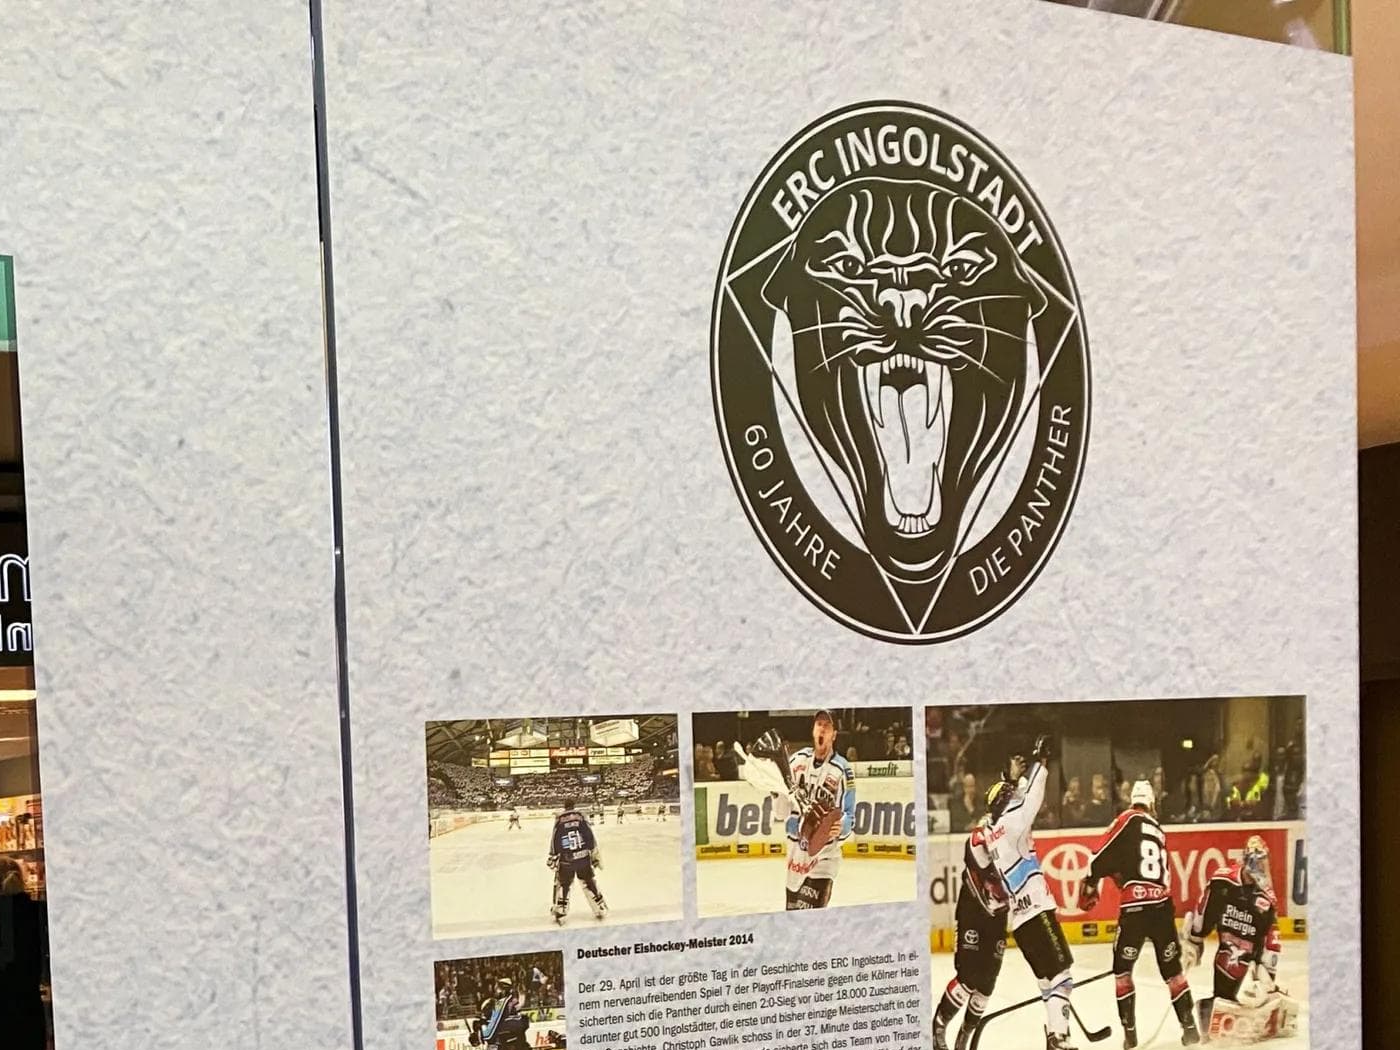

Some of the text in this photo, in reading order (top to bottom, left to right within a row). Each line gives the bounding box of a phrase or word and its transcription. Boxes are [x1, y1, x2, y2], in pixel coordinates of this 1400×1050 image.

[771, 125, 1042, 256] ERC INGOLSTADT
[744, 423, 841, 580] 60 JAHRE
[969, 402, 1073, 596] DIE PANTHER
[716, 793, 772, 837] bet
[1221, 913, 1257, 937] Energie
[1226, 904, 1253, 923] Rhein
[576, 932, 754, 960] Deutscher Eishockey-Meister 2014
[578, 982, 596, 994] Der
[619, 976, 641, 992] April
[644, 975, 657, 988] ist
[658, 974, 676, 986] der
[678, 971, 708, 987] größte
[710, 969, 728, 983] Tag
[730, 968, 742, 979] in
[742, 966, 759, 978] der
[760, 962, 809, 976] Geschichte
[811, 960, 829, 971] des
[830, 956, 849, 969] ERC
[897, 951, 906, 962] In
[578, 966, 920, 1011] nem nervenaufreibenden Spiel 7 der Playoff-Finalserie gegen die Kölner Haie
[578, 1014, 624, 1029] sicherten
[626, 1010, 646, 1023] sich
[648, 1008, 664, 1021] die
[665, 1006, 702, 1019] Panther
[703, 1001, 731, 1015] durch
[732, 1000, 758, 1012] einen
[759, 995, 797, 1009] 2:0-Sieg
[797, 995, 812, 1005] vor
[813, 991, 834, 1003] über
[836, 987, 868, 1001] 18.000
[579, 1031, 622, 1045] darunter
[622, 1028, 639, 1043] gut
[640, 1025, 661, 1039] 500
[719, 1018, 735, 1030] die
[735, 1016, 759, 1028] erste
[759, 1012, 778, 1026] und
[778, 1011, 807, 1023] bisher
[807, 1007, 838, 1020] einzige
[838, 1000, 896, 1016] Meisterschaft
[896, 999, 905, 1010] in
[905, 998, 921, 1009] der
[709, 1034, 740, 1048] Gawlik
[741, 1031, 773, 1044] schoss
[775, 1028, 785, 1040] in
[786, 1027, 802, 1039] der
[820, 1022, 850, 1035] Minute
[852, 1020, 869, 1031] das
[870, 1016, 904, 1031] goldene
[831, 1038, 848, 1050] das
[849, 1036, 873, 1047] Team
[874, 1034, 891, 1044] von
[892, 1030, 921, 1042] Trainer
